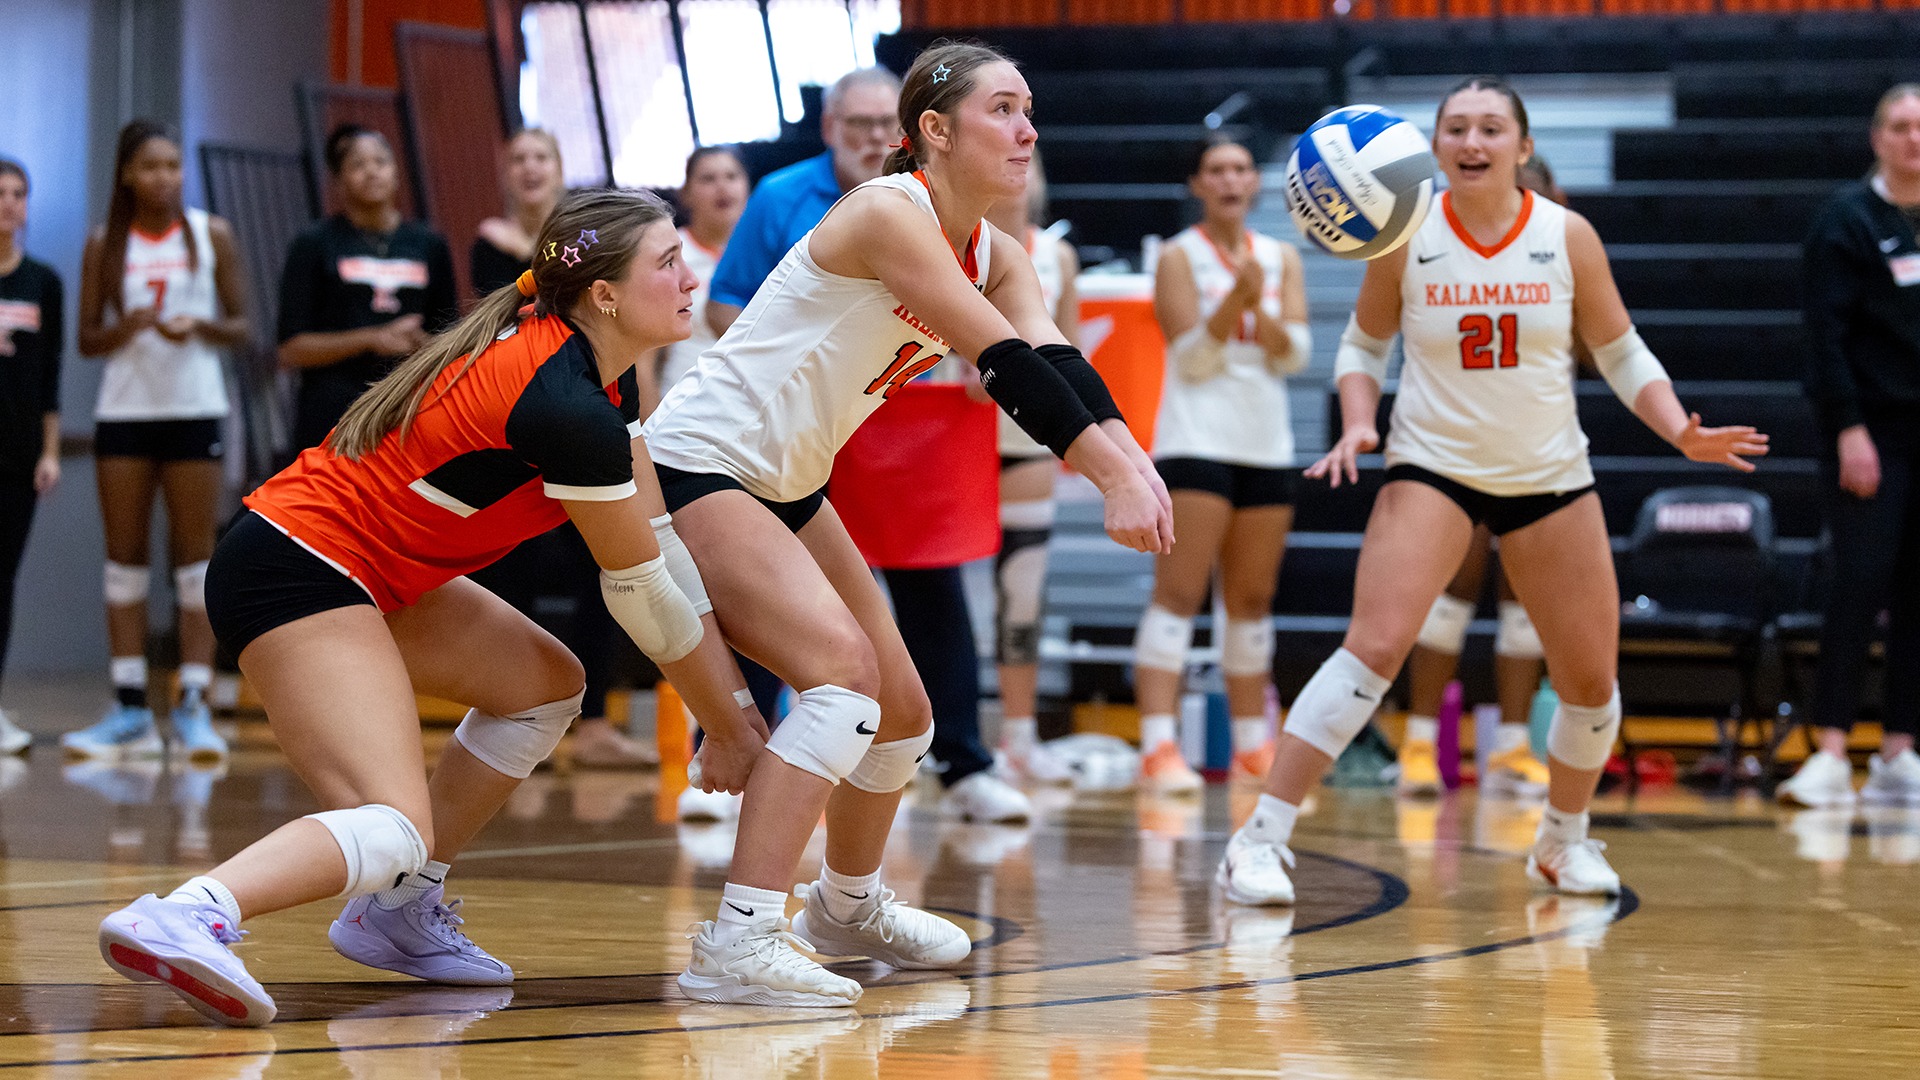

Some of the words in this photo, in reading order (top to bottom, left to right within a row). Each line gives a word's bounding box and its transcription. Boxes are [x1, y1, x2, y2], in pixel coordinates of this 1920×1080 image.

[1289, 173, 1343, 242] molten
[1301, 160, 1357, 227] NCAA
[146, 278, 168, 311] 7
[1425, 282, 1551, 307] KALAMAZOO
[863, 340, 944, 400] 14
[1458, 312, 1519, 370] 21
